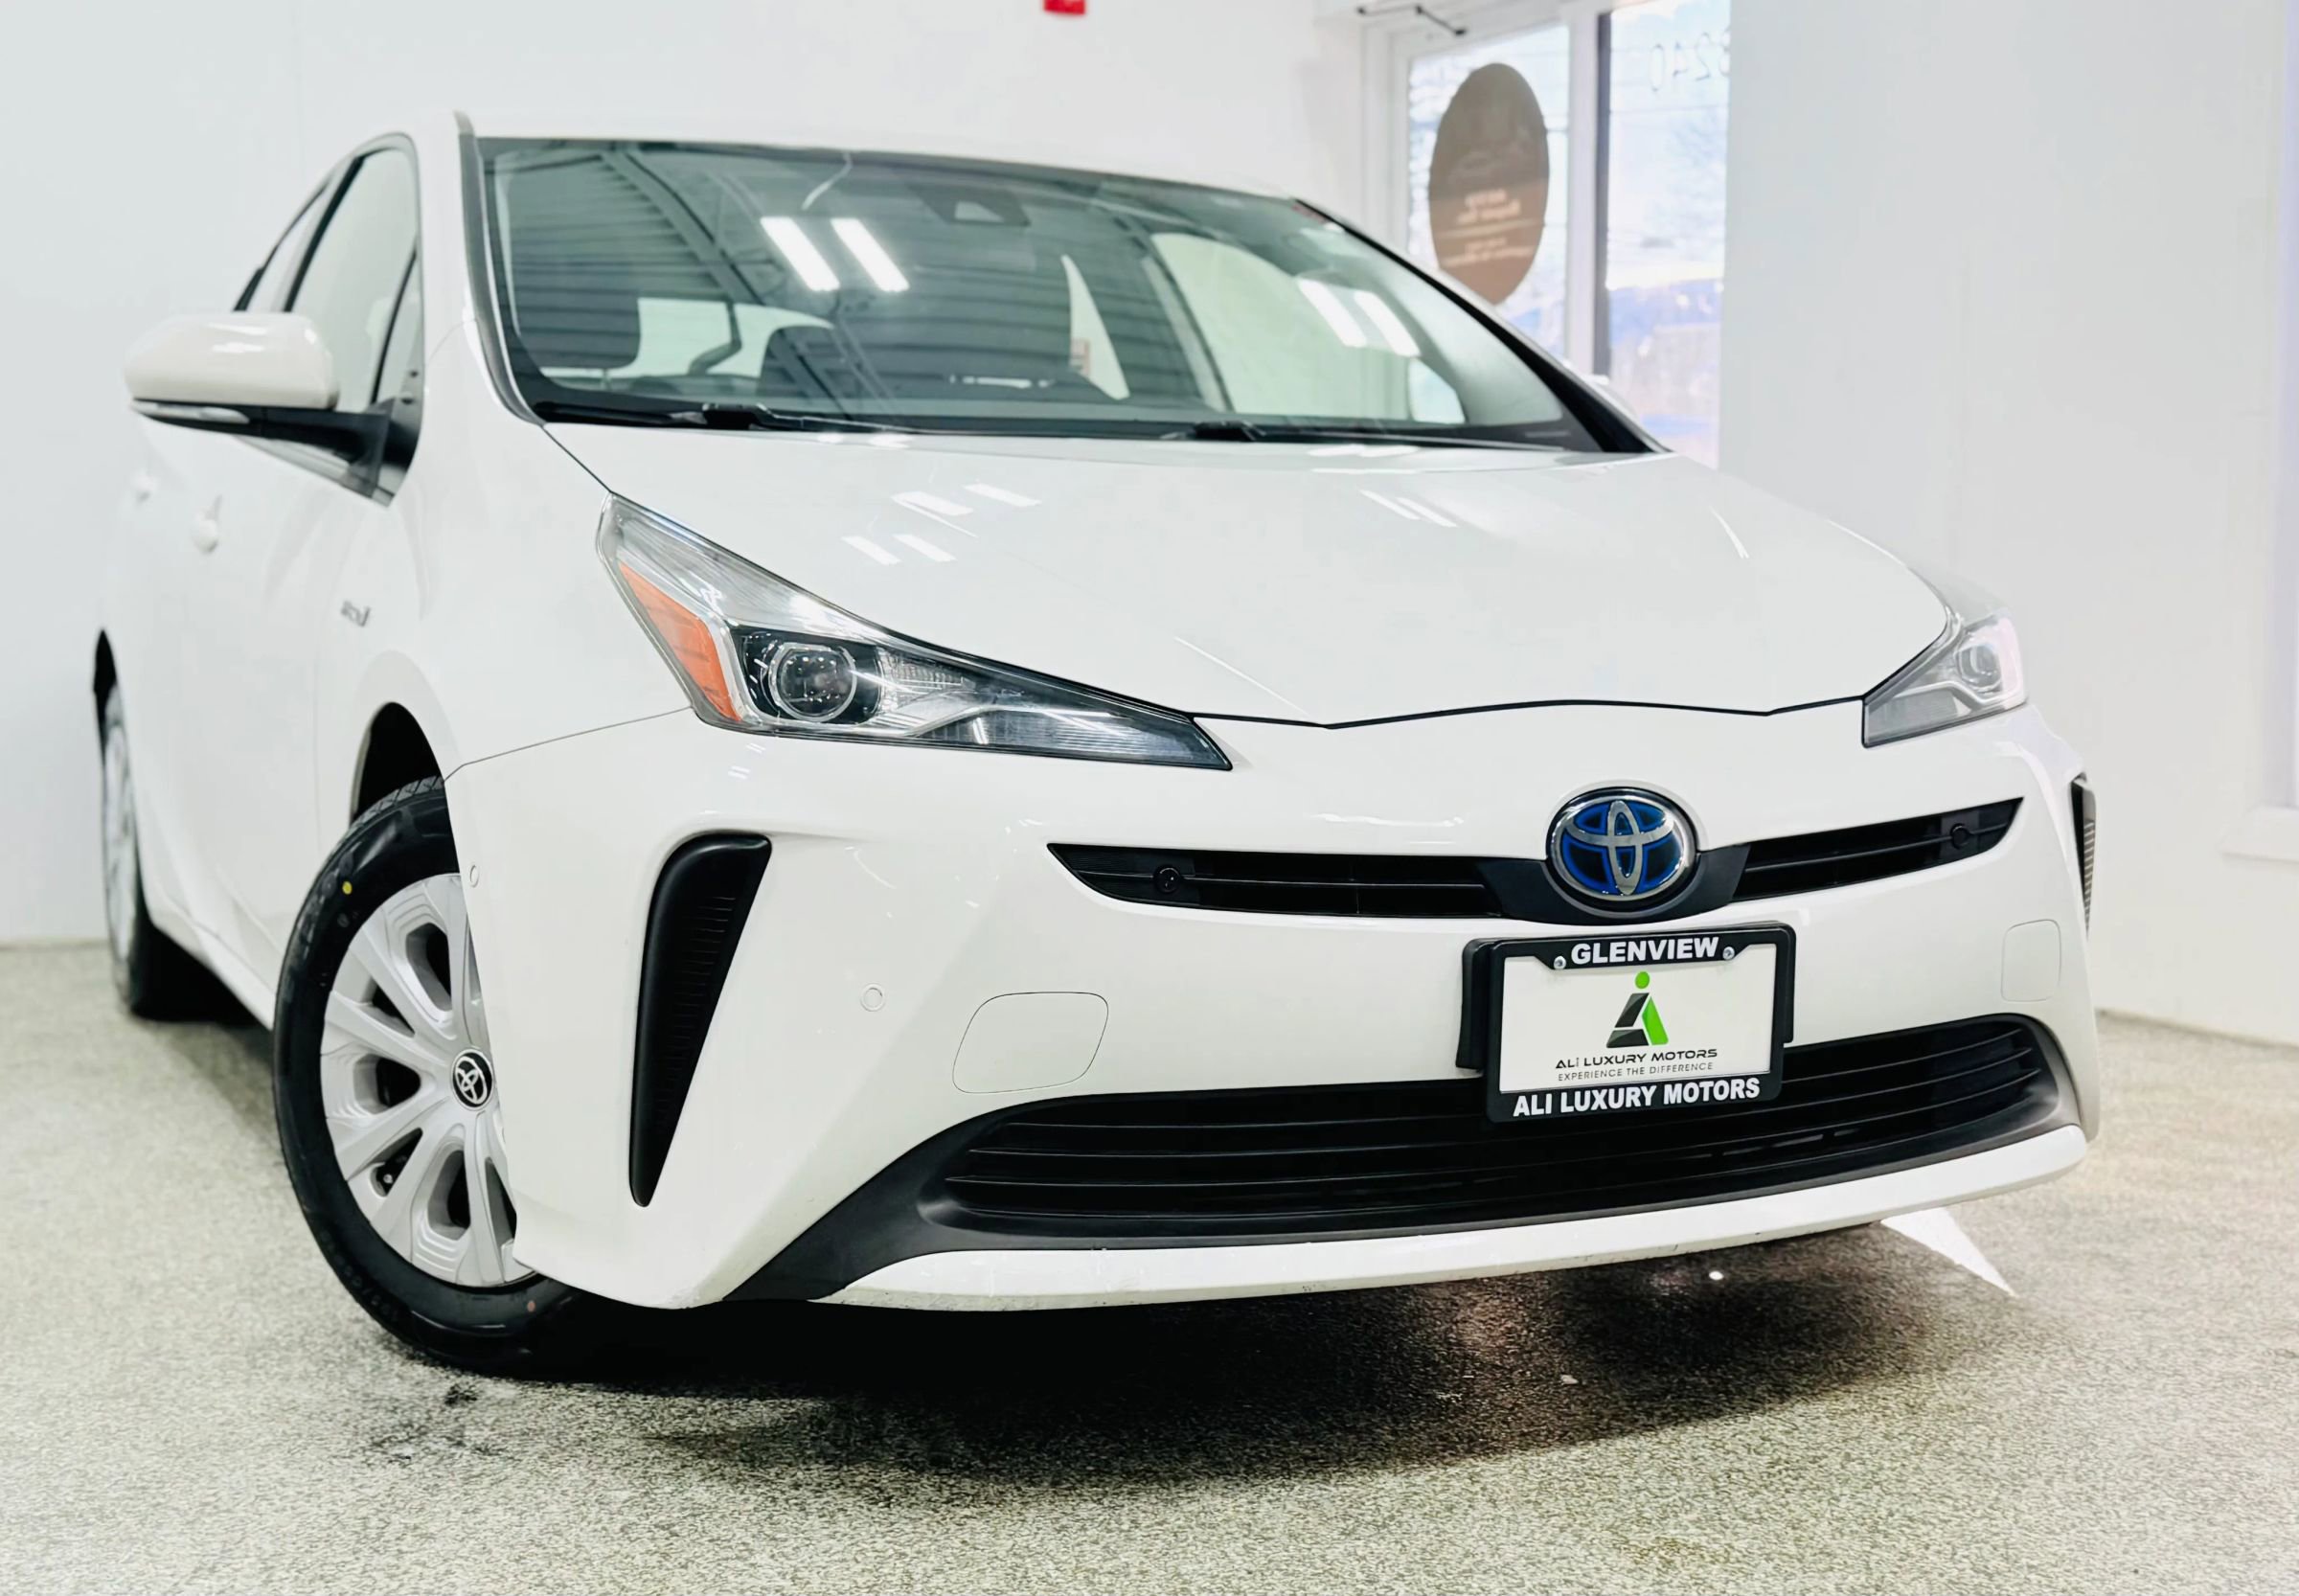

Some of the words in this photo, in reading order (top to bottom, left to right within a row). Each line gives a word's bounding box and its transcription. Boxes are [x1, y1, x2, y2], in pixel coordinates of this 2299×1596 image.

[1571, 937, 1719, 965] GLENVIEW
[1583, 1053, 1648, 1066] LUXURY
[1650, 1048, 1718, 1062] MOTORS
[1558, 1068, 1623, 1082] EXPERIENCE
[1627, 1066, 1645, 1076] THE
[1649, 1062, 1714, 1074] DIFFERENCE
[1513, 1093, 1553, 1118] ALI
[1560, 1084, 1657, 1112] LUXURY
[1663, 1078, 1761, 1106] MOTORS
